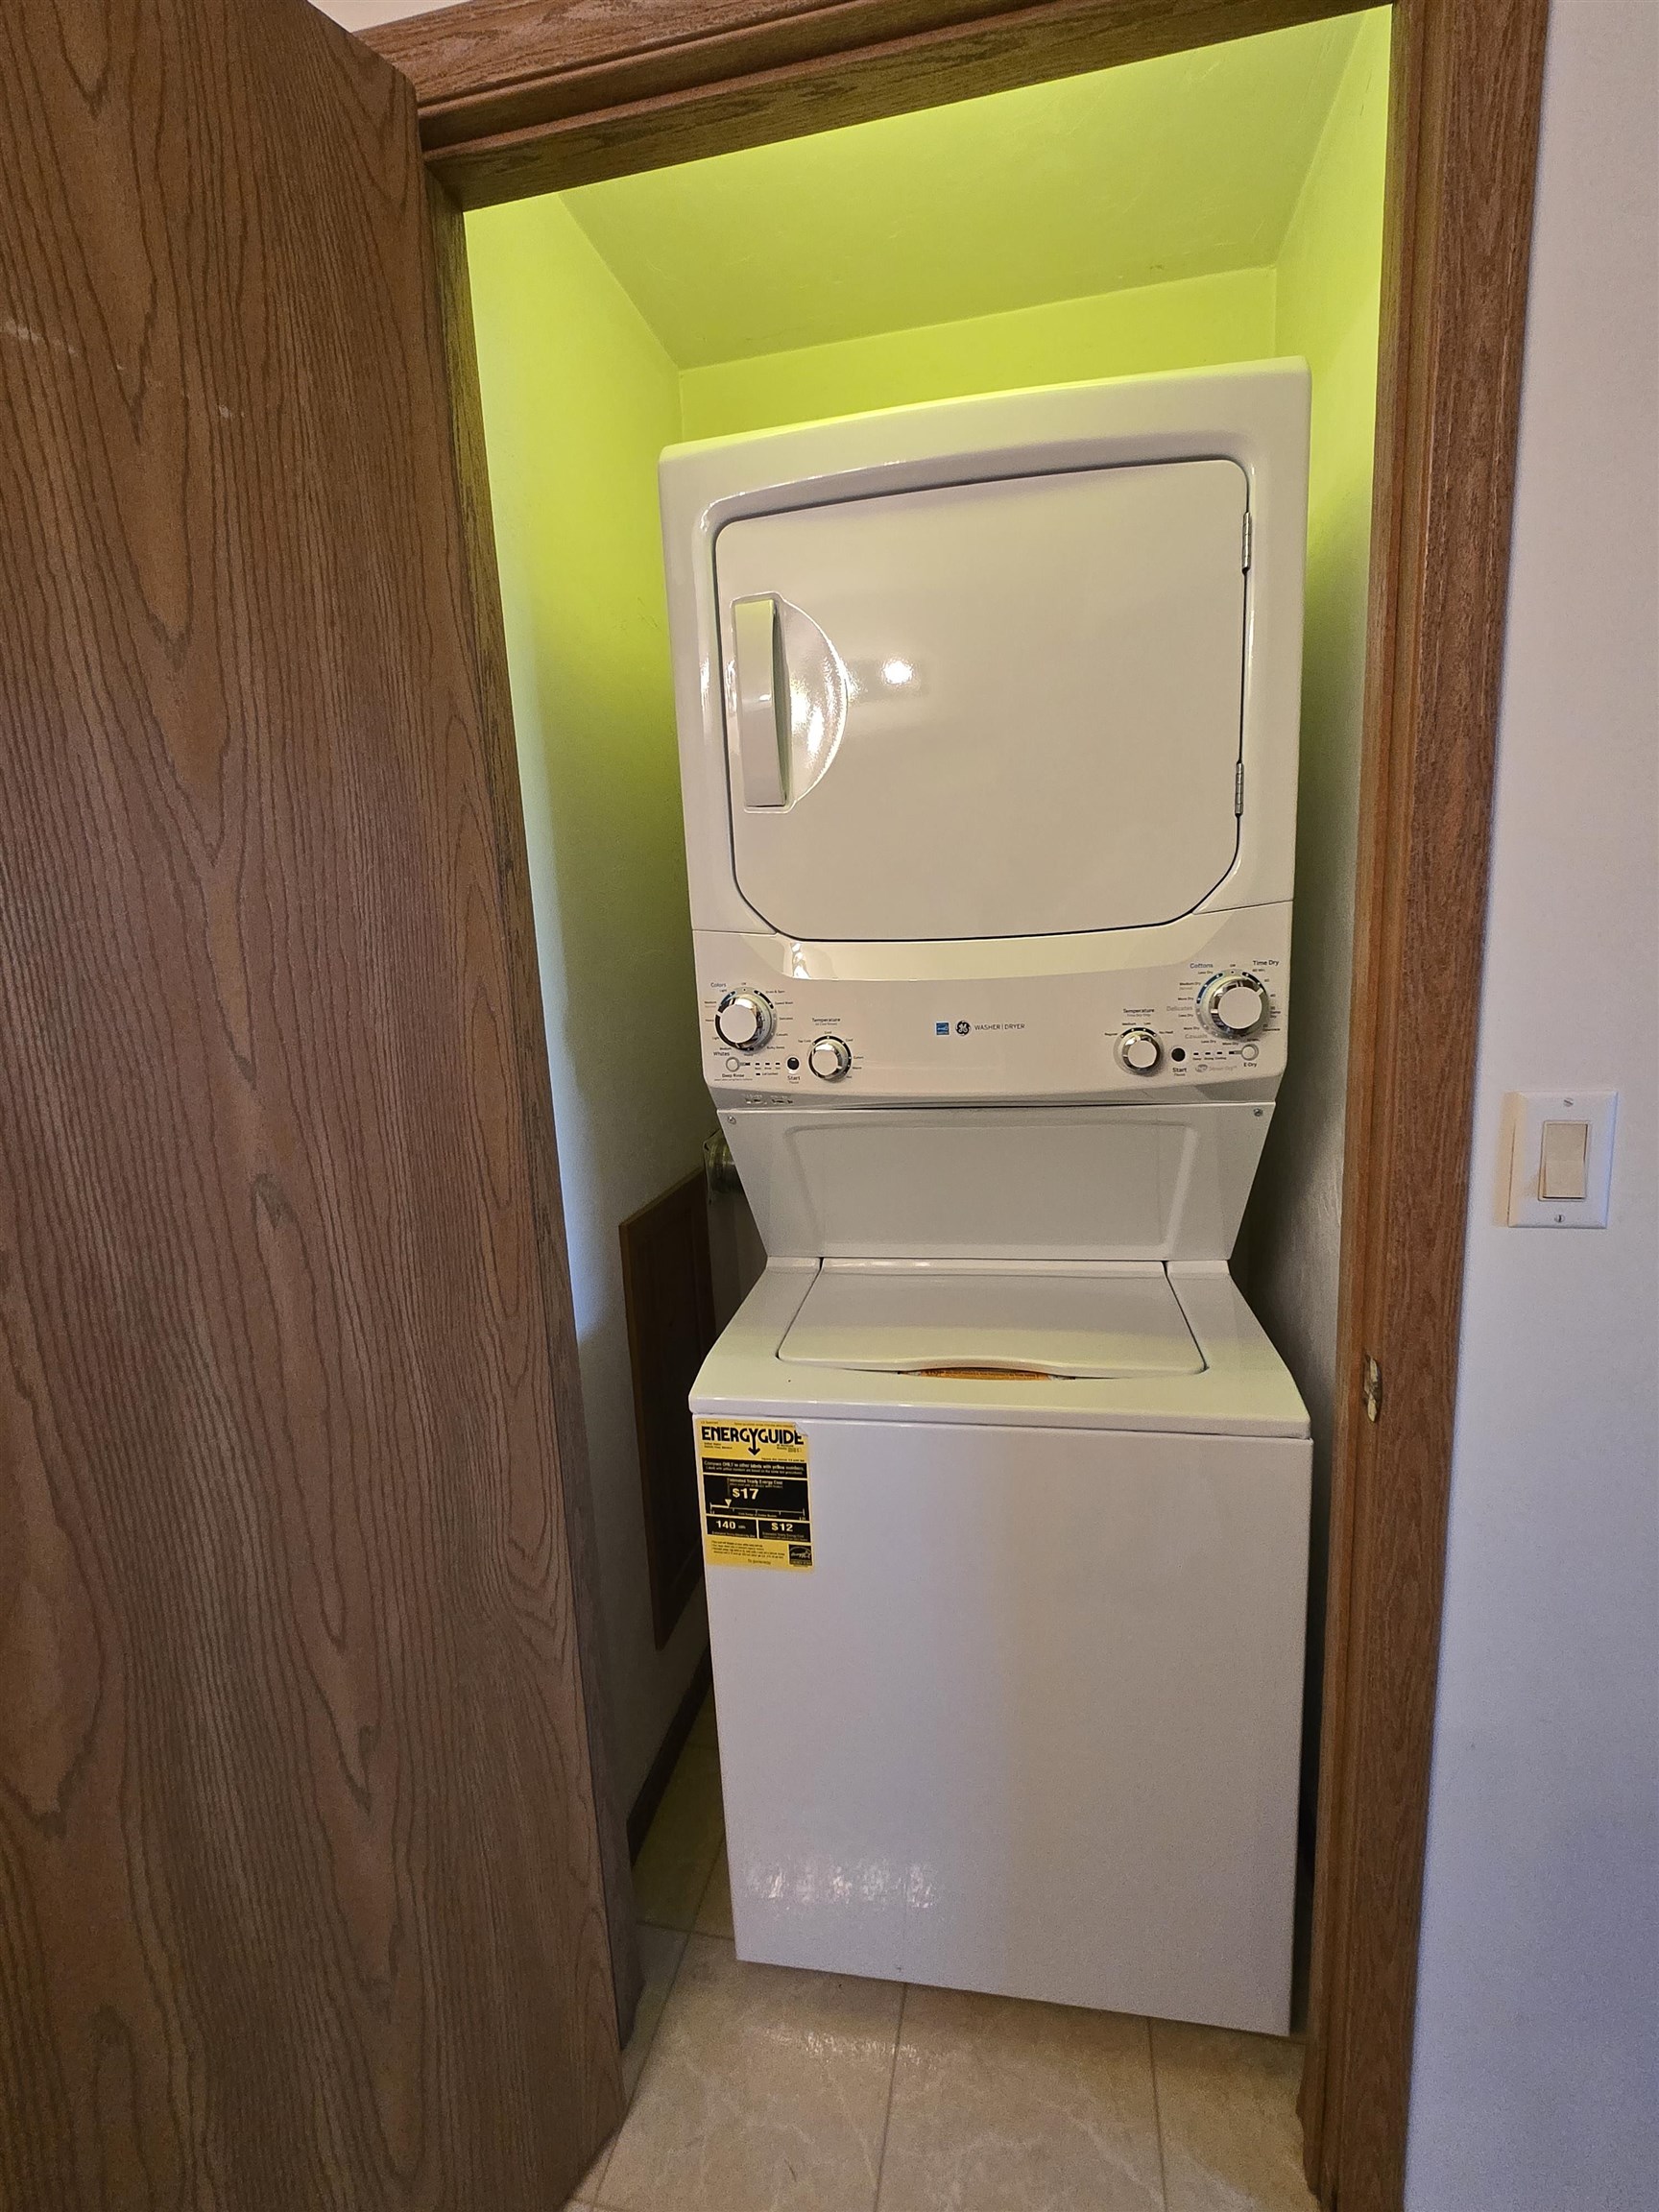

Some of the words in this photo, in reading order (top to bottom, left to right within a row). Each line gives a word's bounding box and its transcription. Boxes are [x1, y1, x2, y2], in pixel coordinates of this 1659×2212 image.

[702, 1426, 804, 1444] ENERGYGUIDE
[733, 1488, 758, 1500] $17
[771, 1523, 793, 1531] $12
